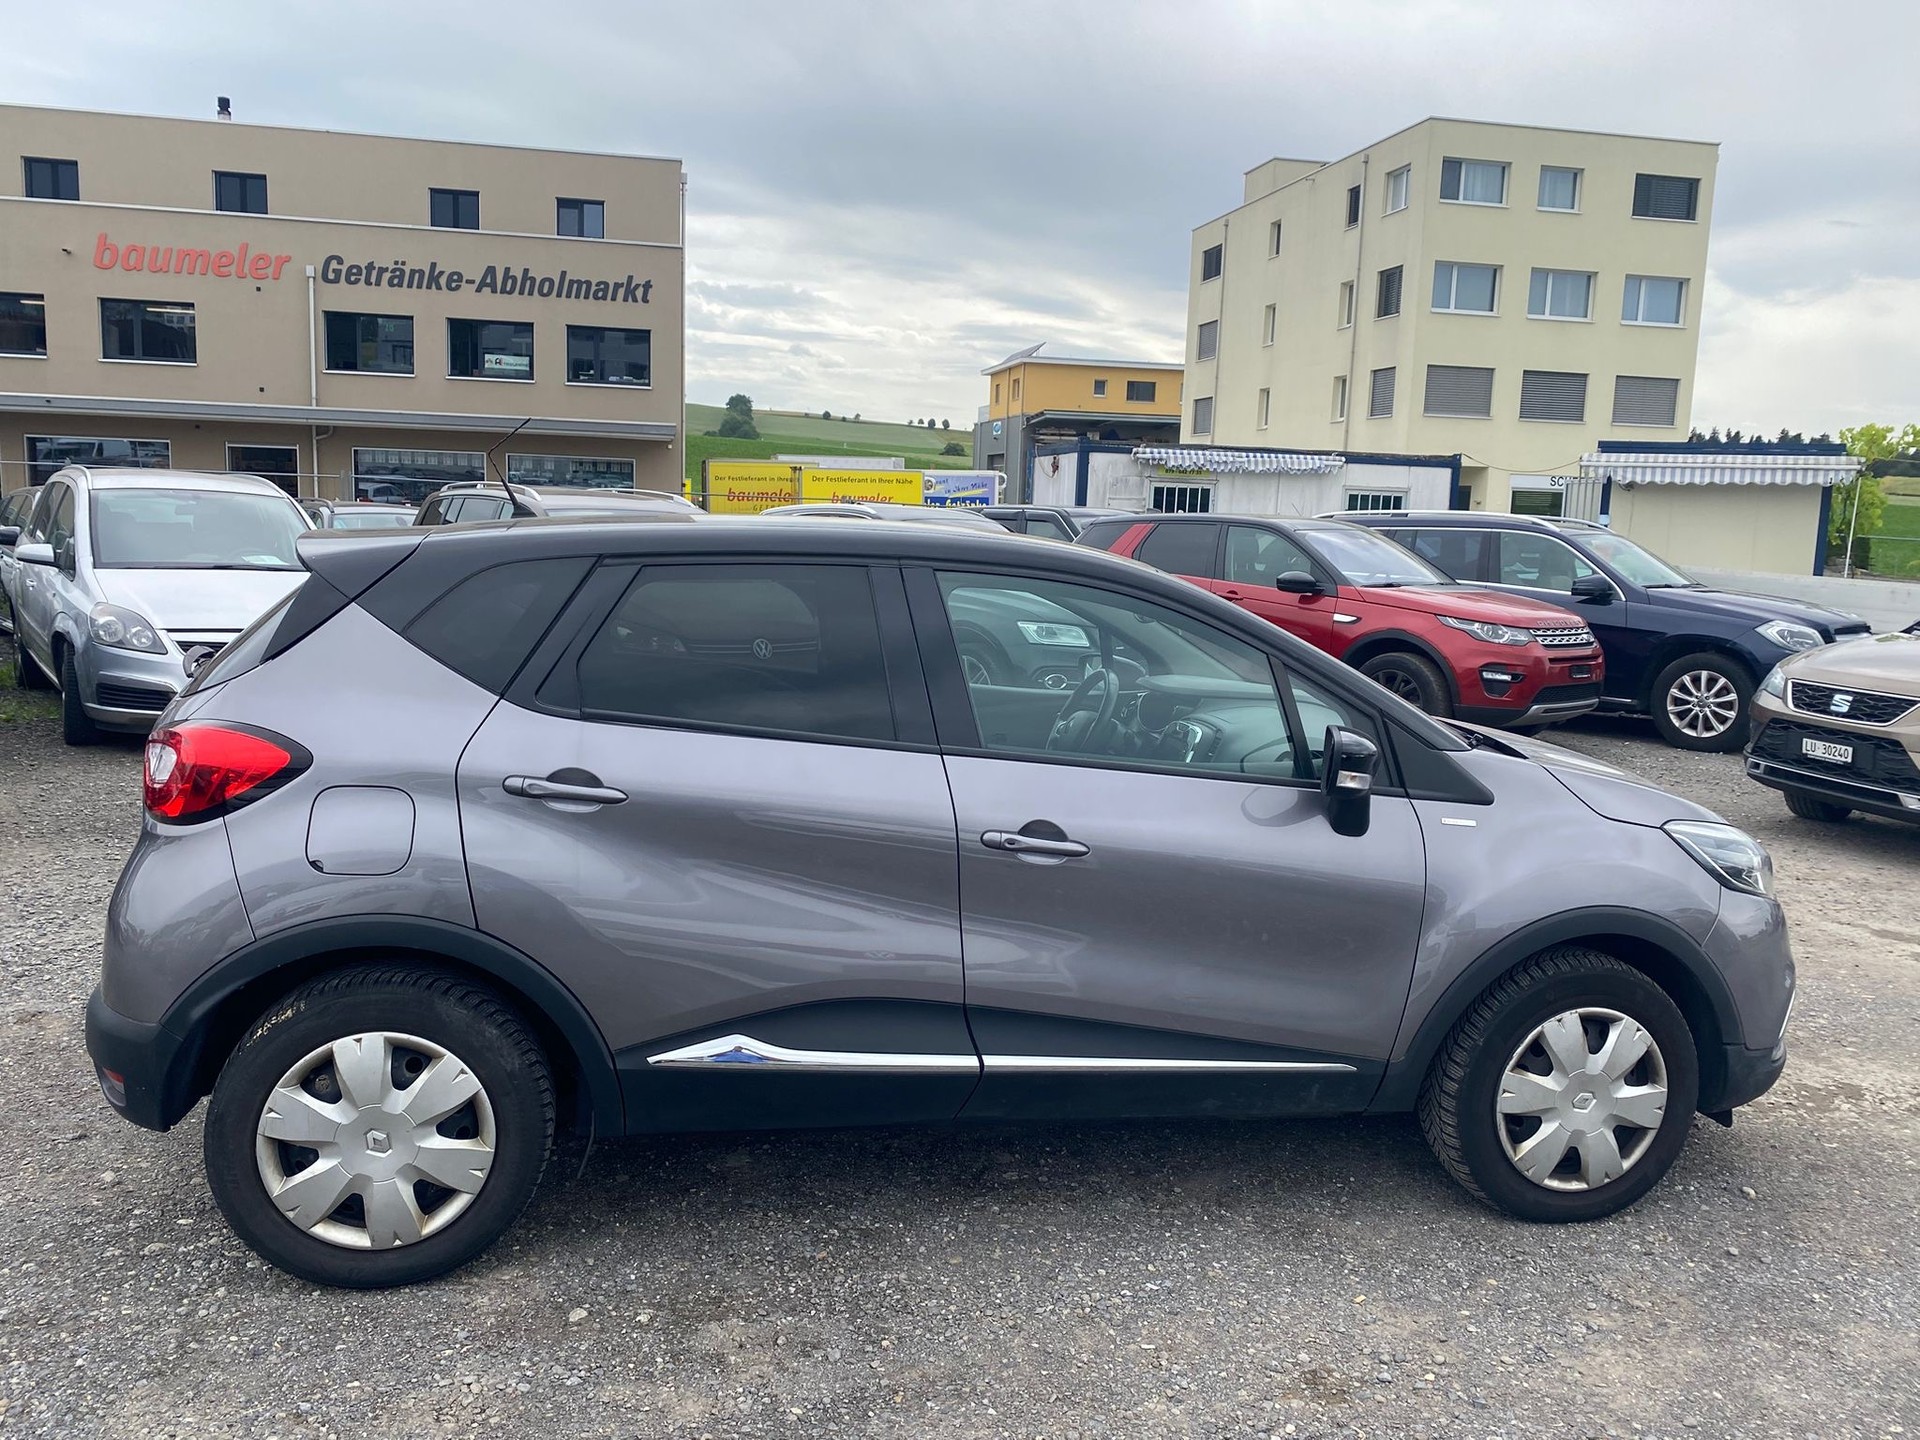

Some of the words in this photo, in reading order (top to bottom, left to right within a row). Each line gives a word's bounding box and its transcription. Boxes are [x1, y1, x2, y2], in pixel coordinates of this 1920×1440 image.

[93, 232, 292, 280] baumeler
[321, 254, 653, 304] Getränke-Abholmarkt
[826, 475, 868, 483] Festlieferant
[1805, 740, 1817, 753] LU
[1821, 743, 1850, 760] 30240
